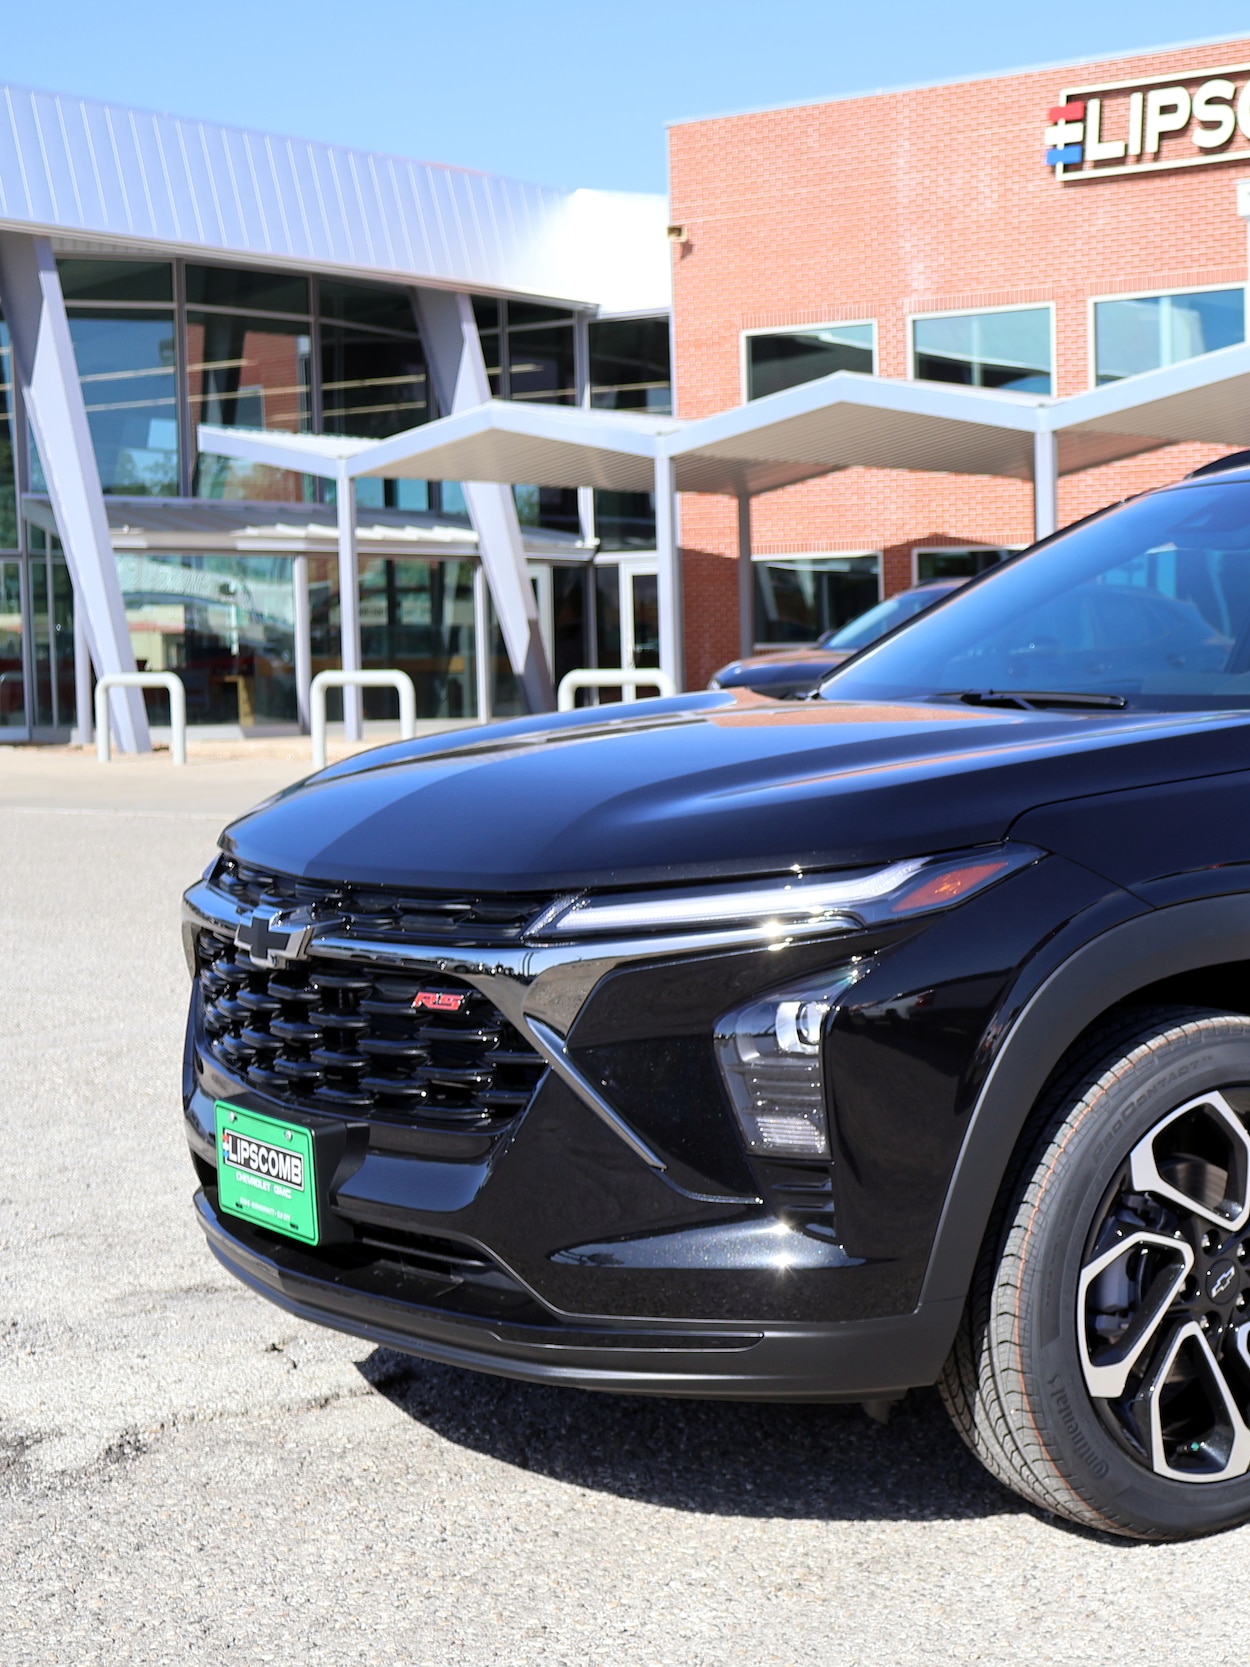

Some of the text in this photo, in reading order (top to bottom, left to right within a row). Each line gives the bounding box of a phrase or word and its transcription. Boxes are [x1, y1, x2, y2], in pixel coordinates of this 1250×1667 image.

[411, 991, 465, 1011] RS
[228, 1134, 303, 1184] LIPSCOMB
[235, 1170, 271, 1193] CHEVROLET
